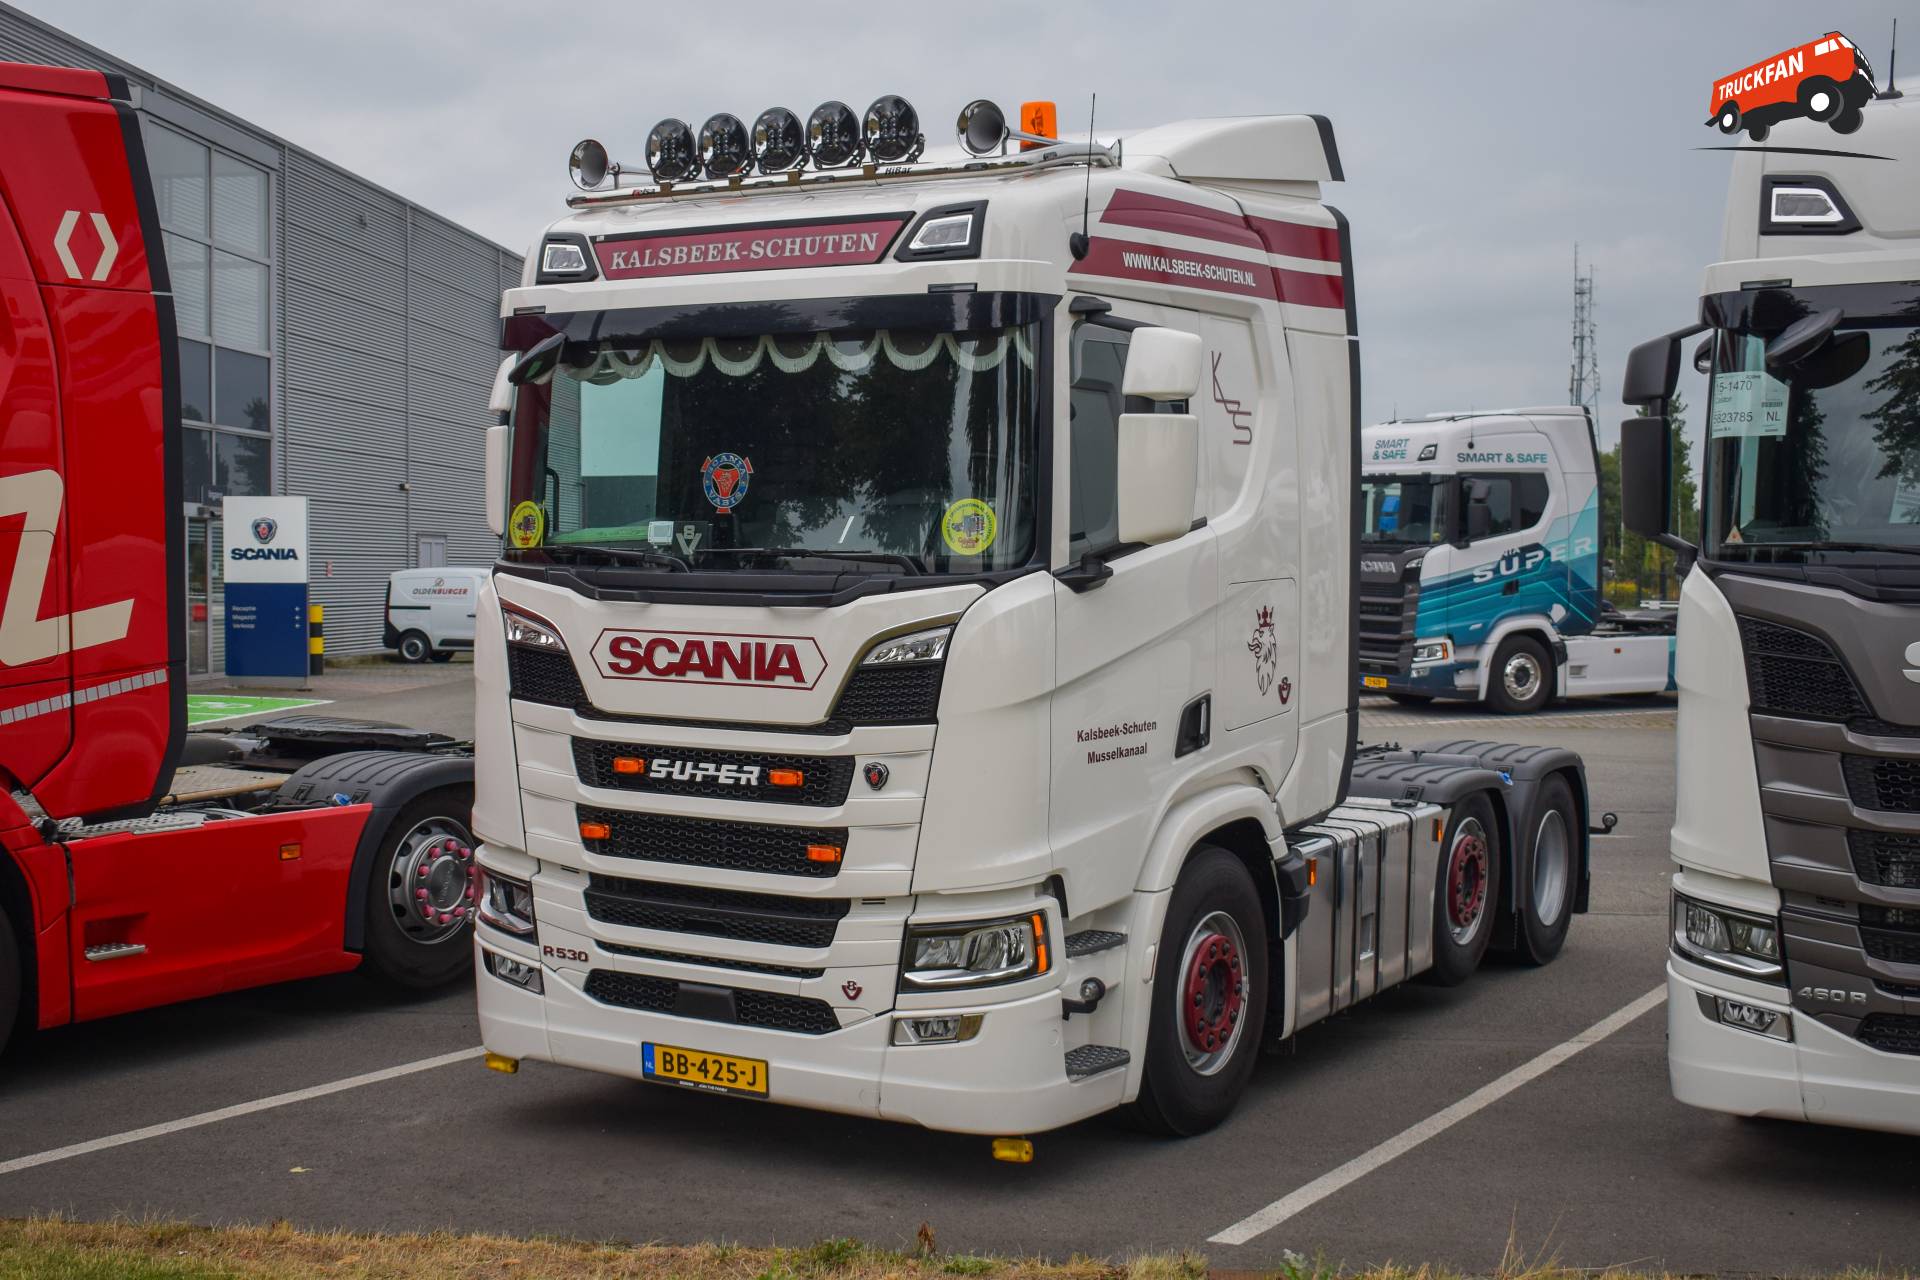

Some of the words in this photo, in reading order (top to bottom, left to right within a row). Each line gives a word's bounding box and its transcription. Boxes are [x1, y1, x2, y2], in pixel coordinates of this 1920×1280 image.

[610, 232, 879, 270] KALSBEEK-SCHUTEN
[1122, 251, 1256, 287] WWW.KALSBEEK-SCHUTEN.NL
[1766, 410, 1781, 422] NL
[1374, 438, 1410, 449] SMART
[1381, 449, 1408, 460] SAFE
[1456, 452, 1503, 464] SMART
[1505, 452, 1515, 464] &
[1516, 453, 1549, 464] SAFE
[230, 547, 299, 561] SCANIA
[1472, 537, 1592, 584] SUPER
[607, 635, 808, 684] SCANIA
[1076, 720, 1157, 743] Kalsbeek-Schuten
[1087, 742, 1148, 764] Musselkanaal
[649, 758, 760, 786] SUPER
[662, 1051, 757, 1087] BB-425-J
